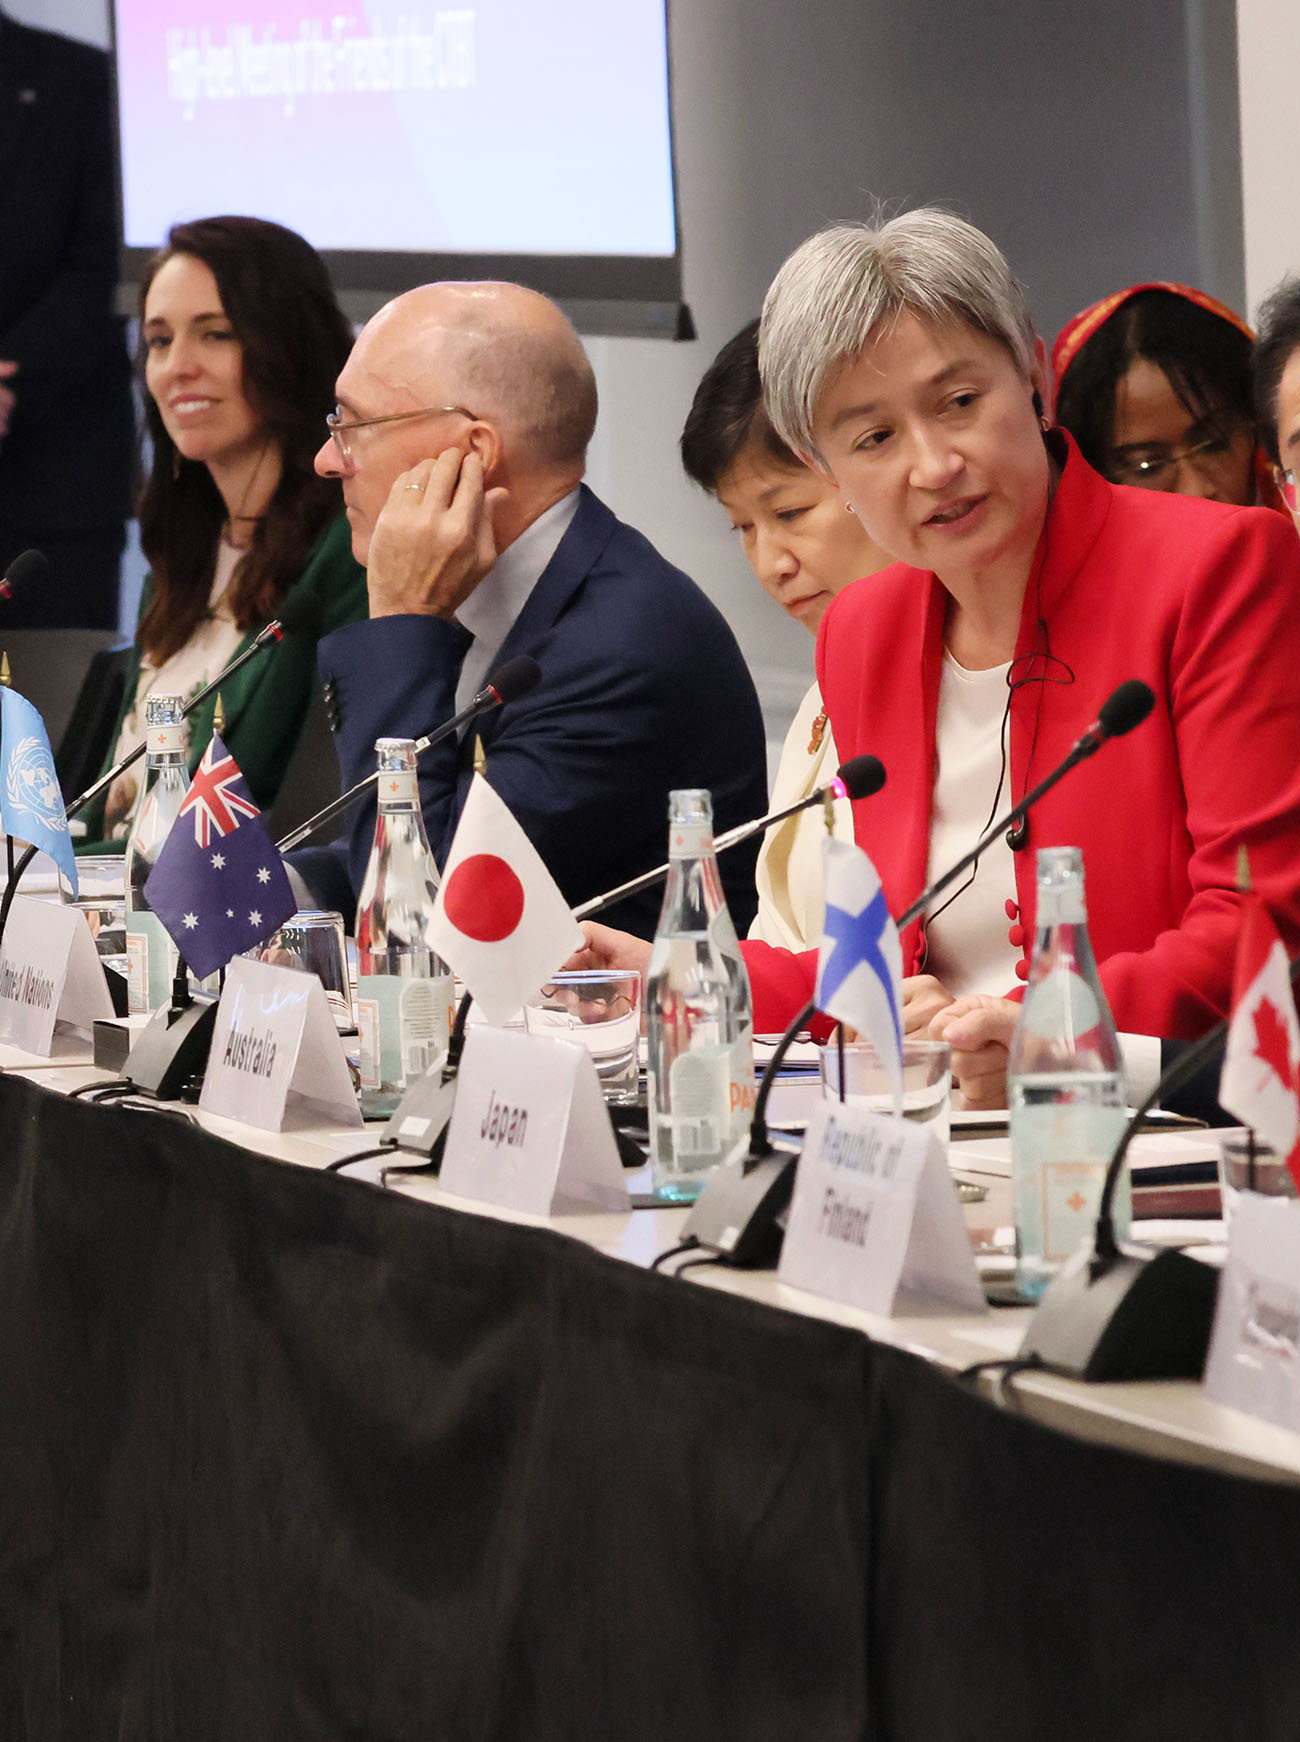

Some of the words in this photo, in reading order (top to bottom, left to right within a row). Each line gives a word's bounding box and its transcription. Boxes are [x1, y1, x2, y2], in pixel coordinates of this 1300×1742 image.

[223, 1019, 277, 1078] Australia
[480, 1089, 528, 1149] Japan
[817, 1187, 874, 1248] Finland
